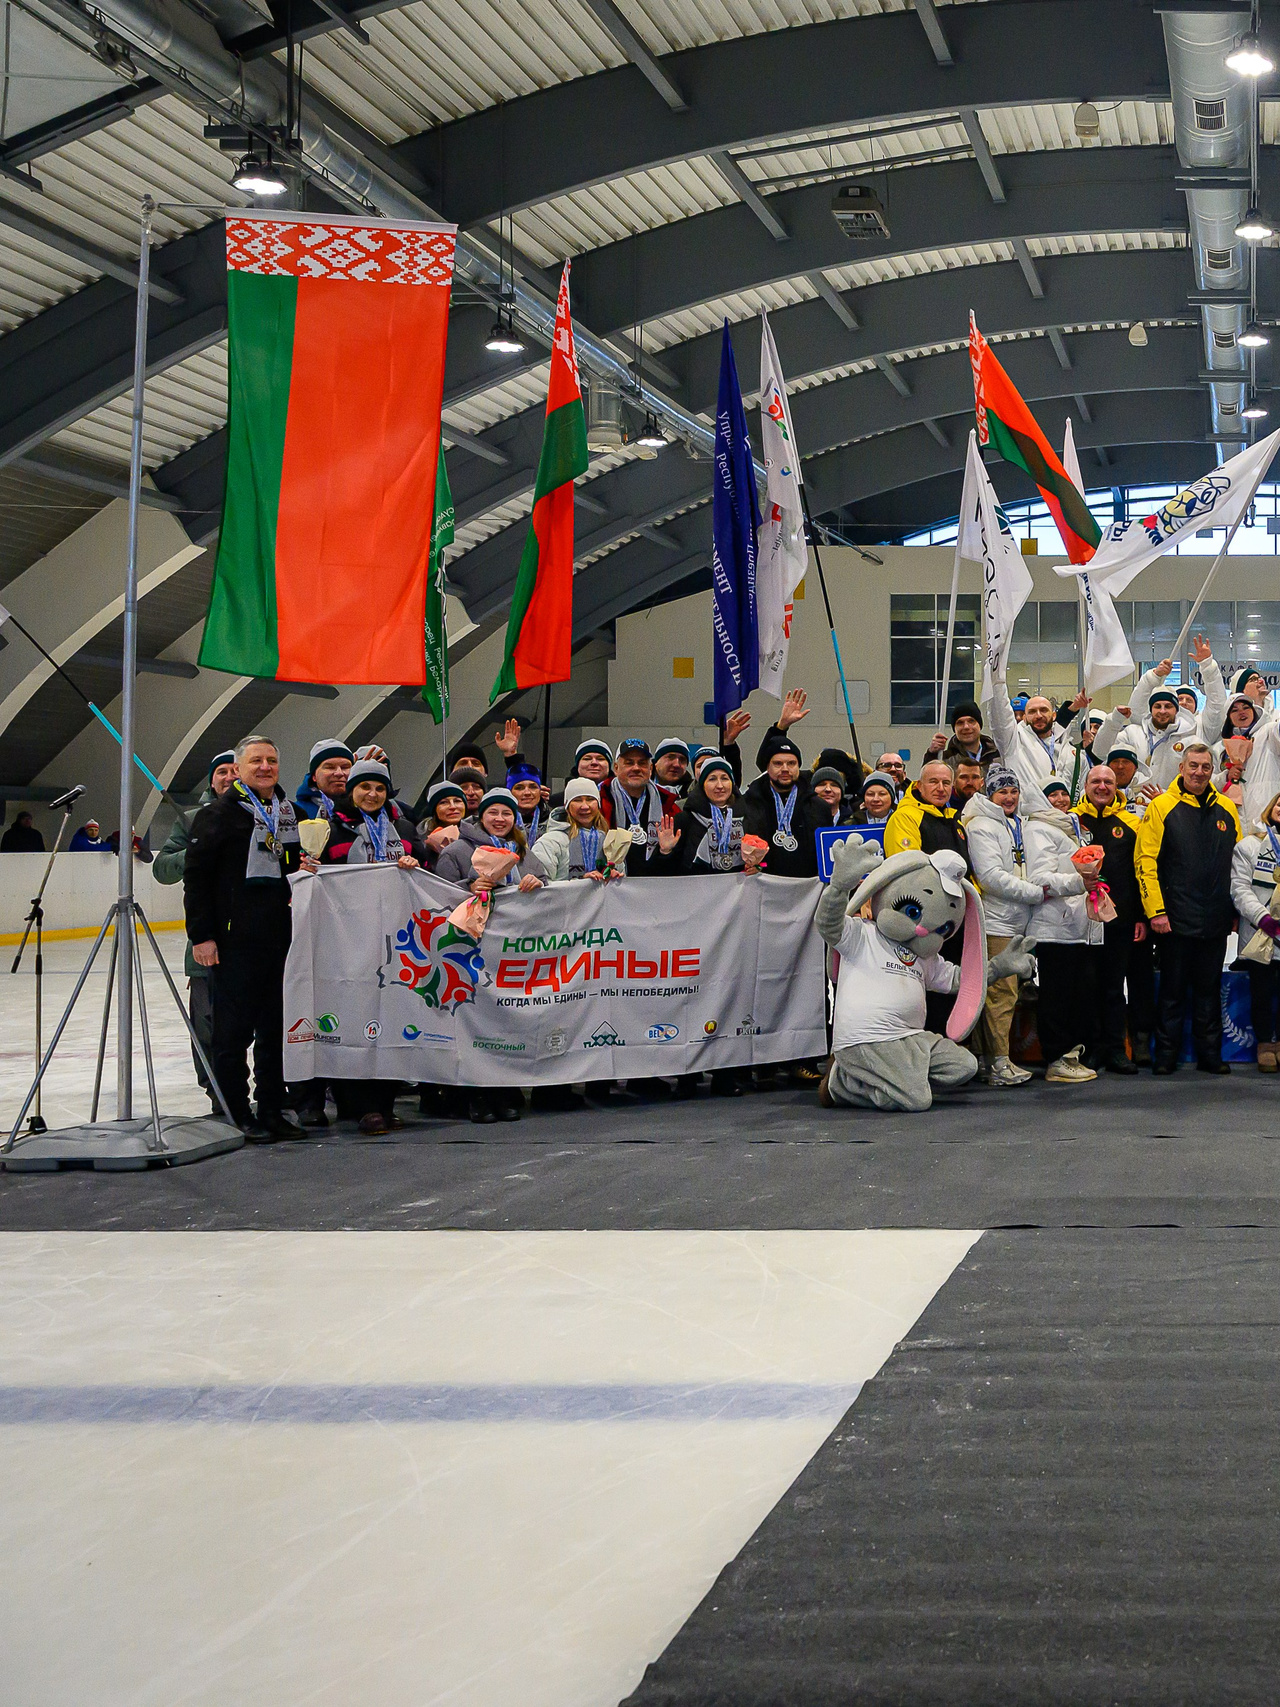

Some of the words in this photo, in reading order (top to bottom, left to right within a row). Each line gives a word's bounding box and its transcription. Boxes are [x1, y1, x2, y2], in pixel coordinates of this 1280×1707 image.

[502, 928, 624, 953] КОМАНДА
[496, 948, 700, 995] ЕДИНЫЕ
[886, 961, 907, 971] БЕЛЫЕ
[497, 997, 530, 1008] КОГДА
[533, 995, 551, 1005] МЫ
[554, 991, 587, 1004] ЕДИНЫ
[600, 988, 619, 997] МЫ
[621, 985, 700, 997] НЕПОБЕДИМЫ!
[472, 1040, 526, 1051] ВОСТОЧНЫЙ
